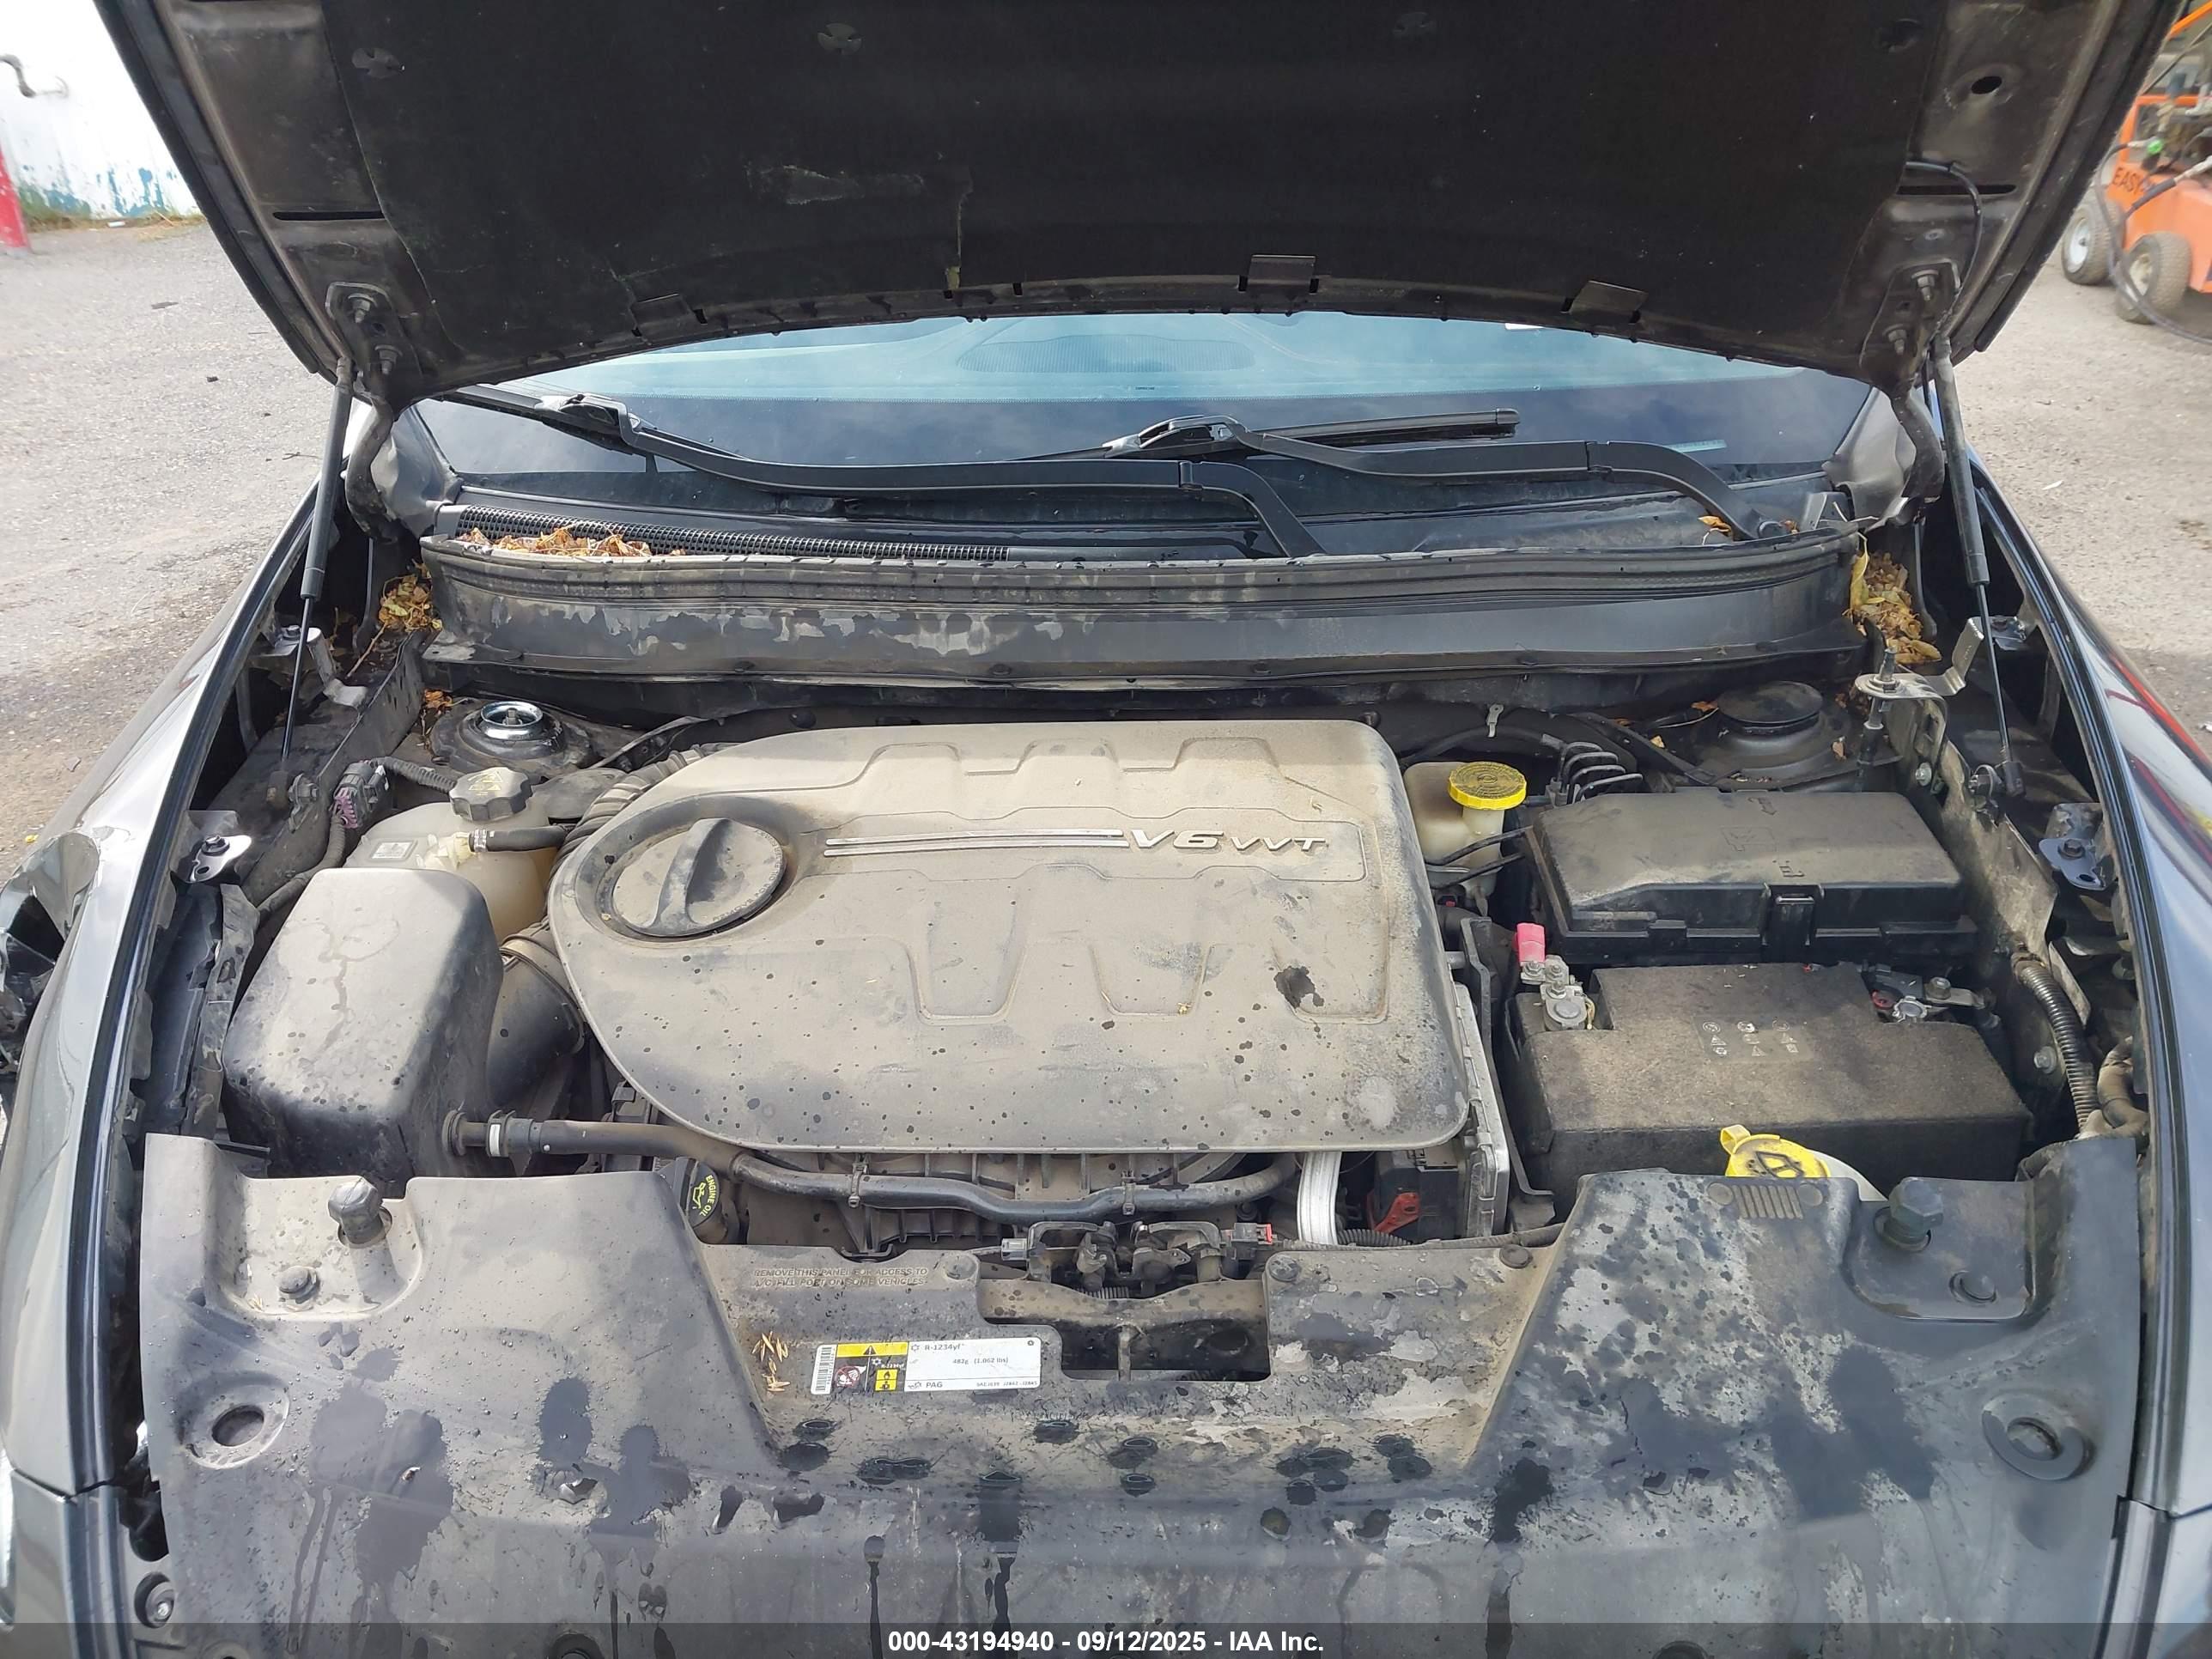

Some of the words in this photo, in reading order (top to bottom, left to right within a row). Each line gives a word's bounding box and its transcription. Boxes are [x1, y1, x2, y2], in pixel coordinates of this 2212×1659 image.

[1131, 830, 1224, 849] V6
[1231, 836, 1326, 851] VVT
[768, 869, 779, 882] OIL
[706, 1175, 716, 1204] ENGINE
[699, 1205, 712, 1217] OIL
[915, 1267, 927, 1276] TO
